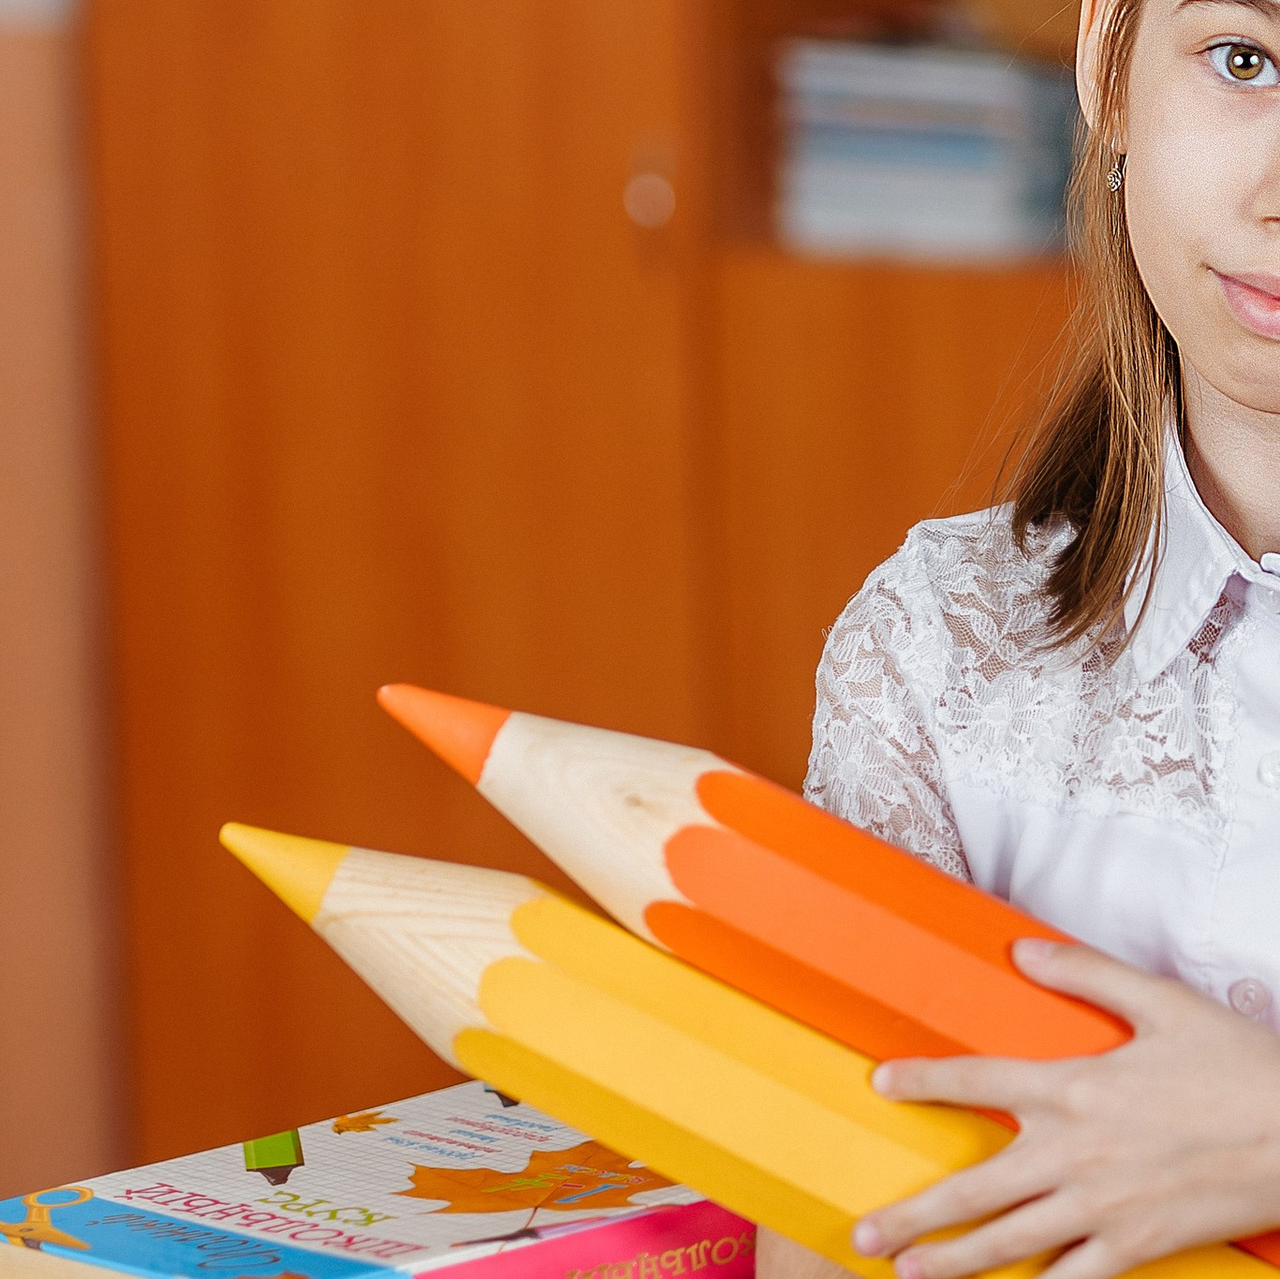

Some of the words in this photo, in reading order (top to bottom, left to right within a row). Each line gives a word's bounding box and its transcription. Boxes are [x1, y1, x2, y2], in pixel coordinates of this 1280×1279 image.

[113, 1182, 429, 1260] ШКОЛЬНЫЙ
[255, 1191, 400, 1228] КУРС
[88, 1212, 281, 1272] Полный
